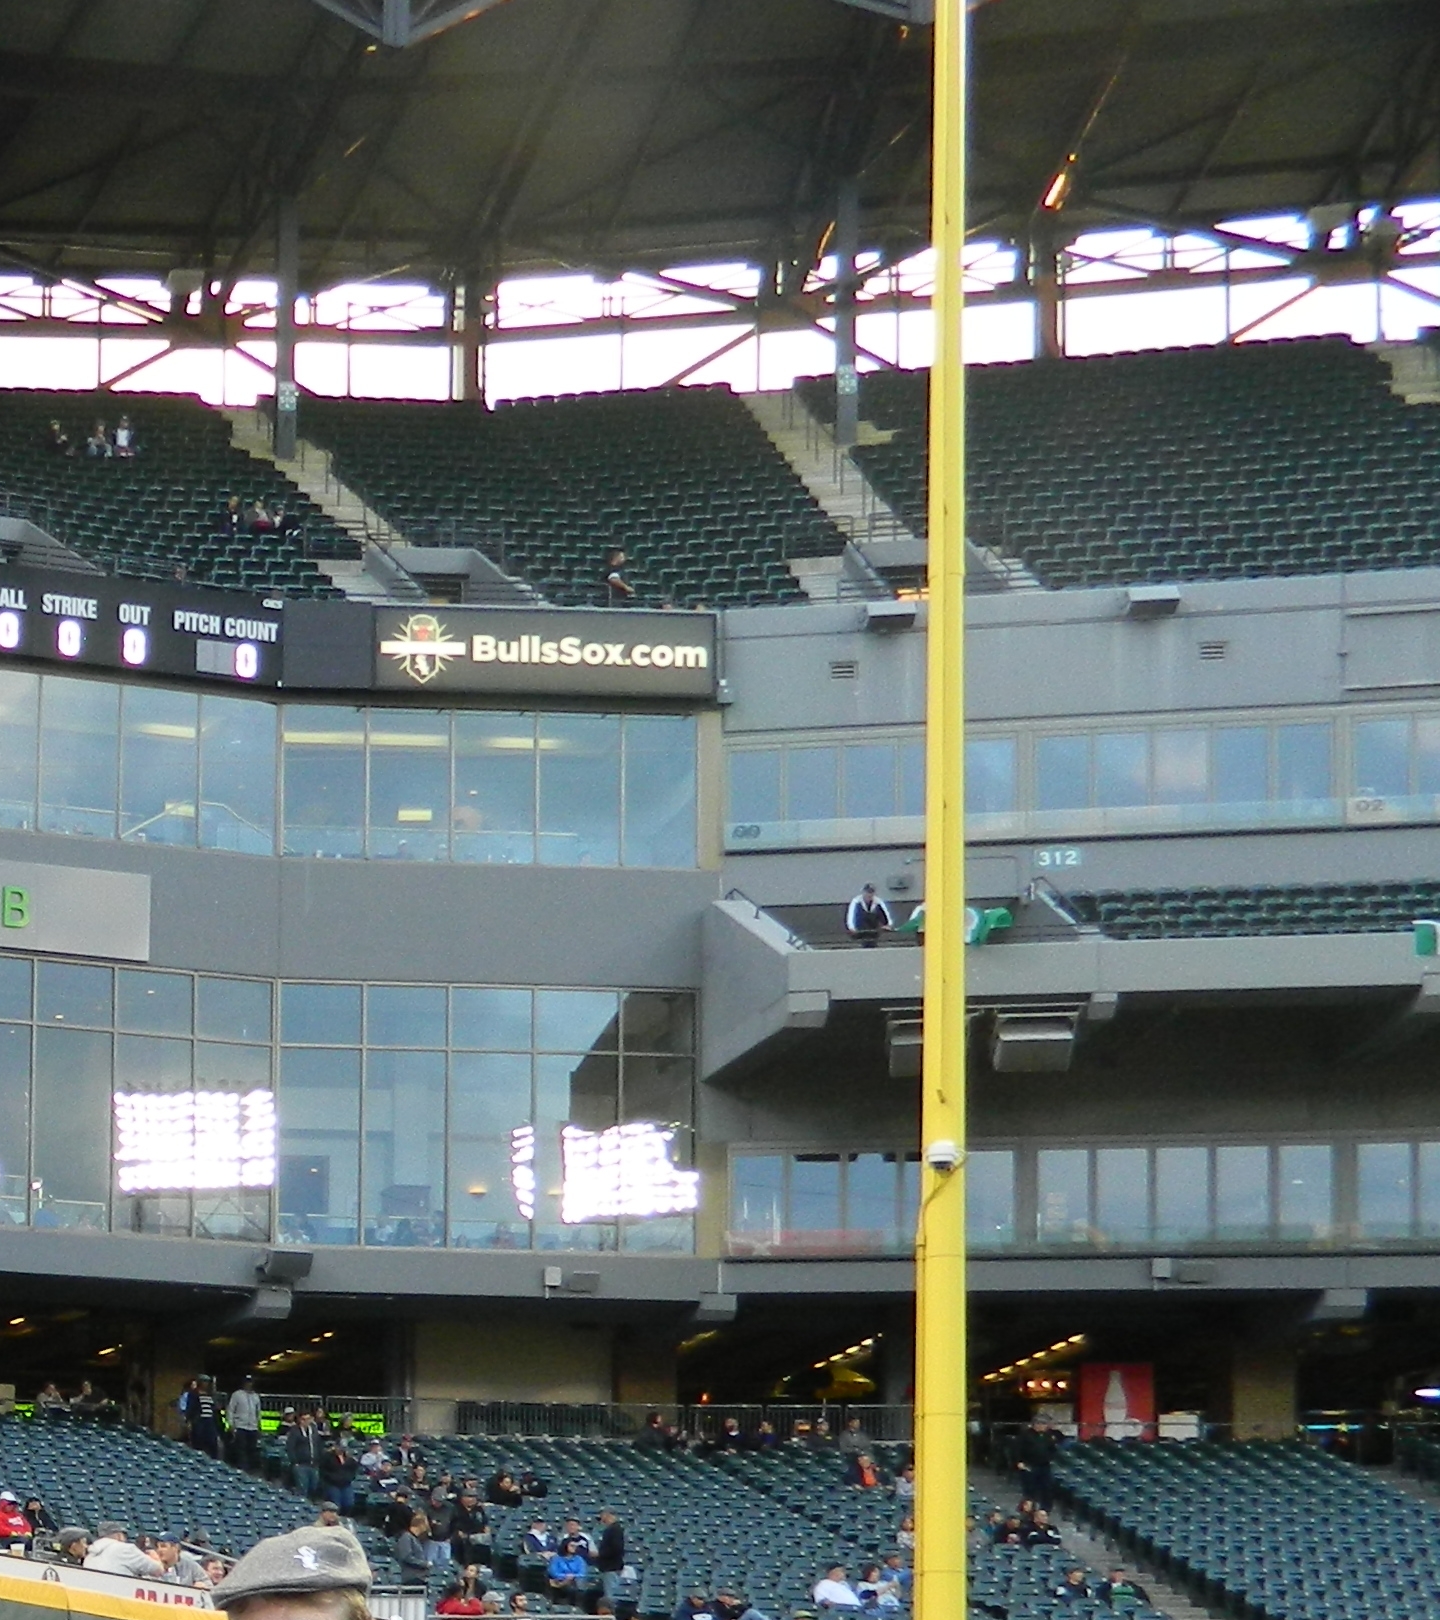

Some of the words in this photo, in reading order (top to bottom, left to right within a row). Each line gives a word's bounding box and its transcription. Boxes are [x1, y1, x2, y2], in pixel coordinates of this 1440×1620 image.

[41, 594, 98, 619] STRIKE
[118, 603, 151, 626] OUT
[173, 610, 220, 635] PITCH
[224, 617, 279, 643] COUNT
[471, 634, 708, 668] BullsSox.com
[1037, 851, 1078, 866] 312
